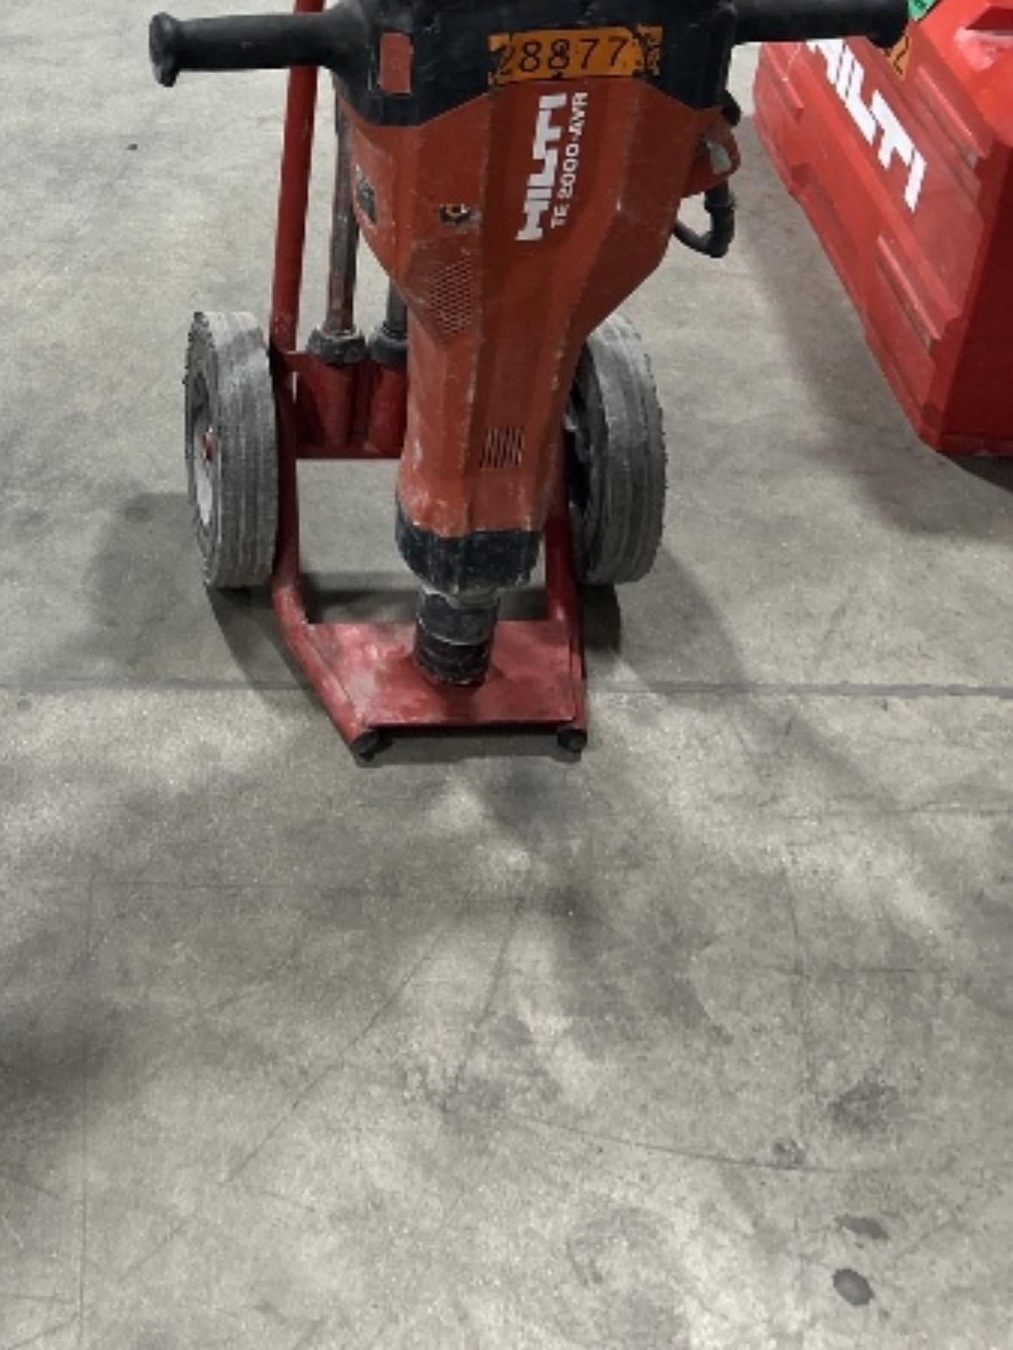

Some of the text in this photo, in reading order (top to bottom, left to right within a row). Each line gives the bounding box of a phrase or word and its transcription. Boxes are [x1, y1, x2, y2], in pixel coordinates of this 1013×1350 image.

[515, 92, 567, 241] HILTI
[550, 92, 588, 229] TE 2000-AVR
